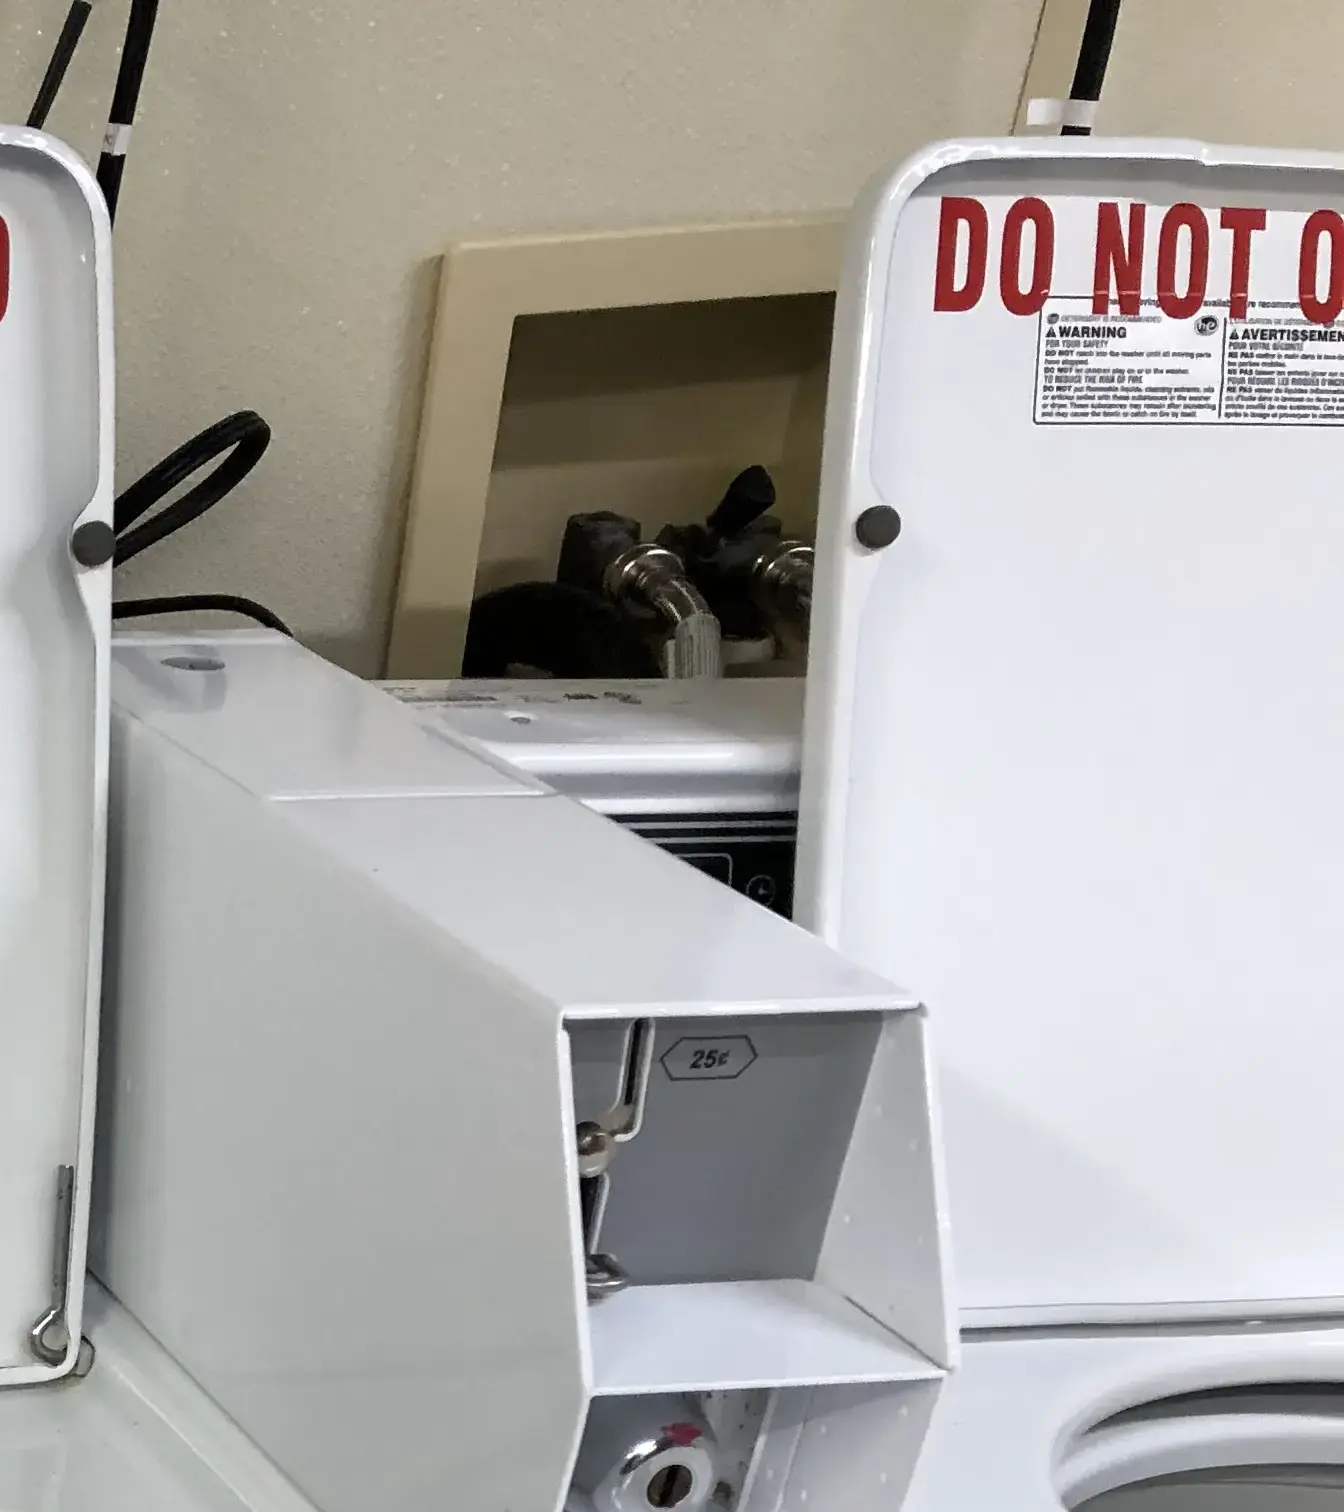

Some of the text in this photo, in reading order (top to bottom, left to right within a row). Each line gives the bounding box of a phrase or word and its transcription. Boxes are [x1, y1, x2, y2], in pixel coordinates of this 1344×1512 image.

[933, 196, 1054, 316] DO
[1092, 203, 1267, 319] NOT
[1058, 326, 1127, 339] WARNING
